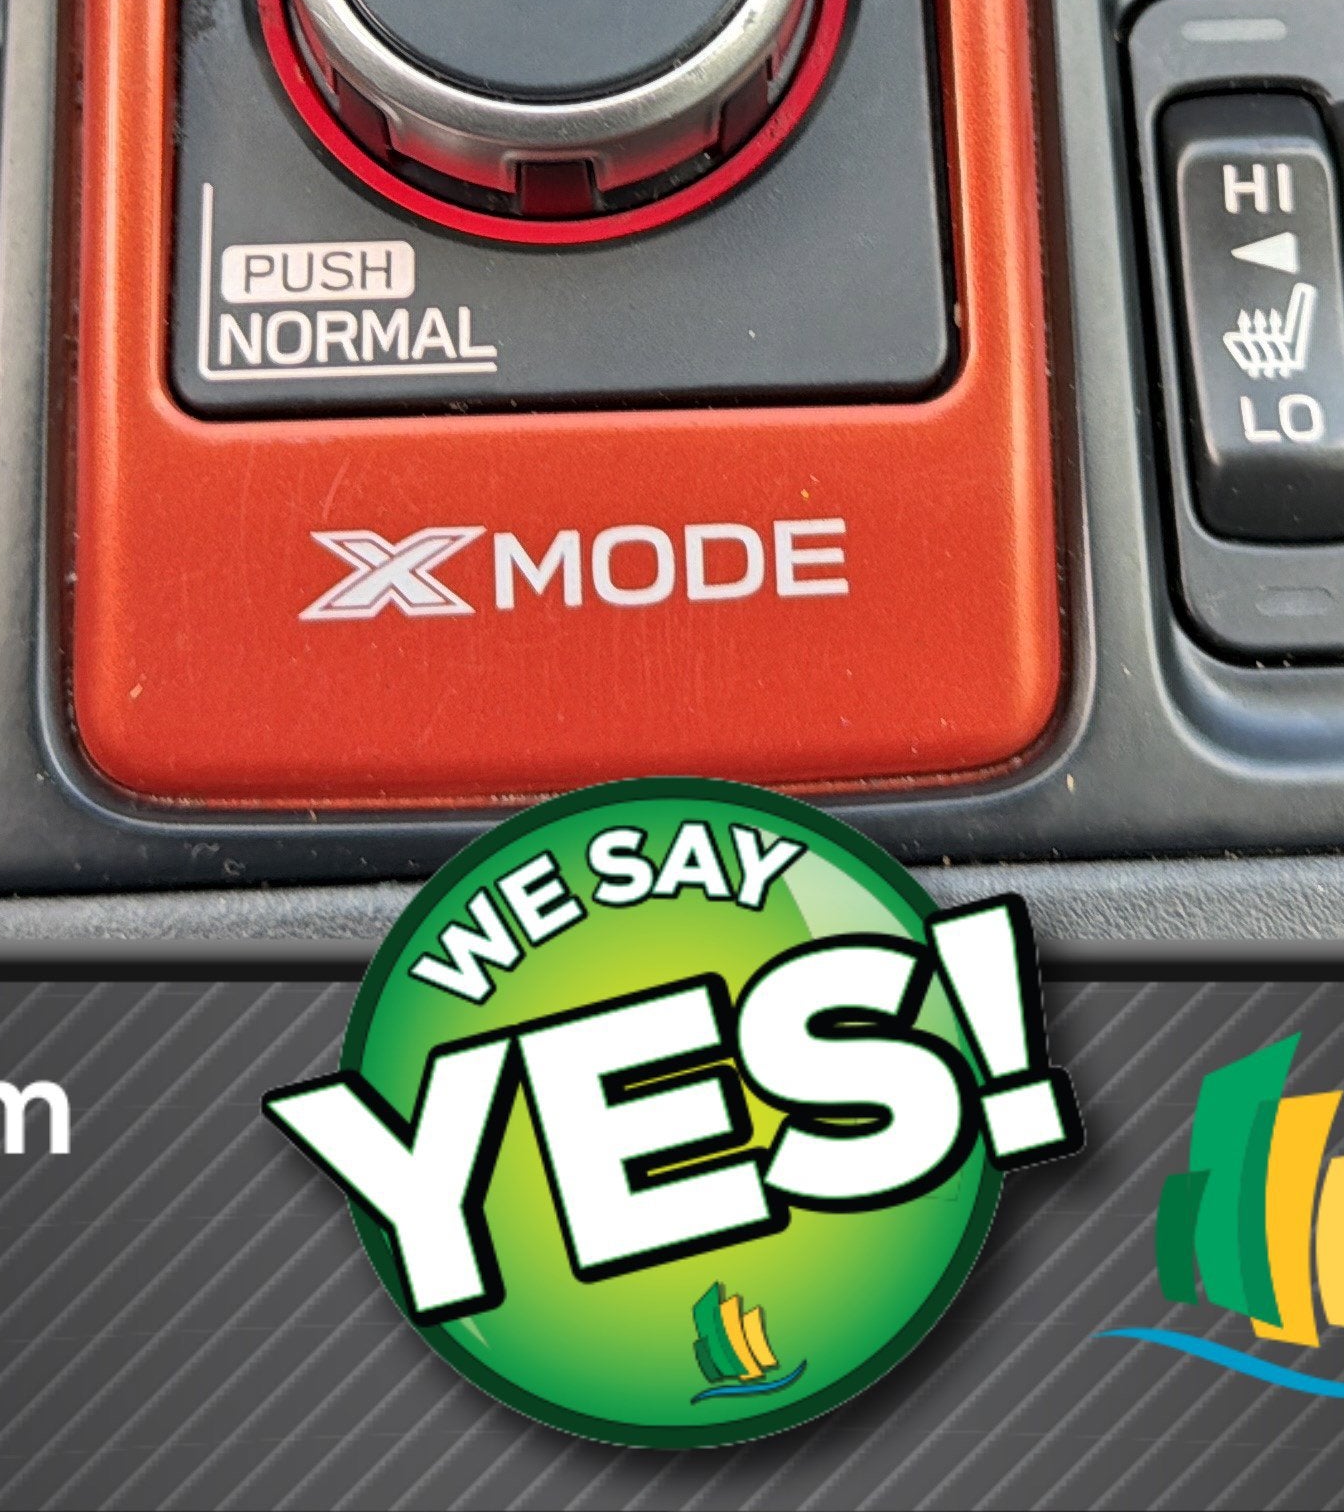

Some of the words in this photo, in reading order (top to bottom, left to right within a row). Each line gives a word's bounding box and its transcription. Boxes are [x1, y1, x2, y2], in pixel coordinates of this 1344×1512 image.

[1222, 162, 1294, 215] HI
[243, 248, 395, 295] PUSH
[218, 305, 498, 366] NORMAL
[1239, 392, 1325, 444] LO
